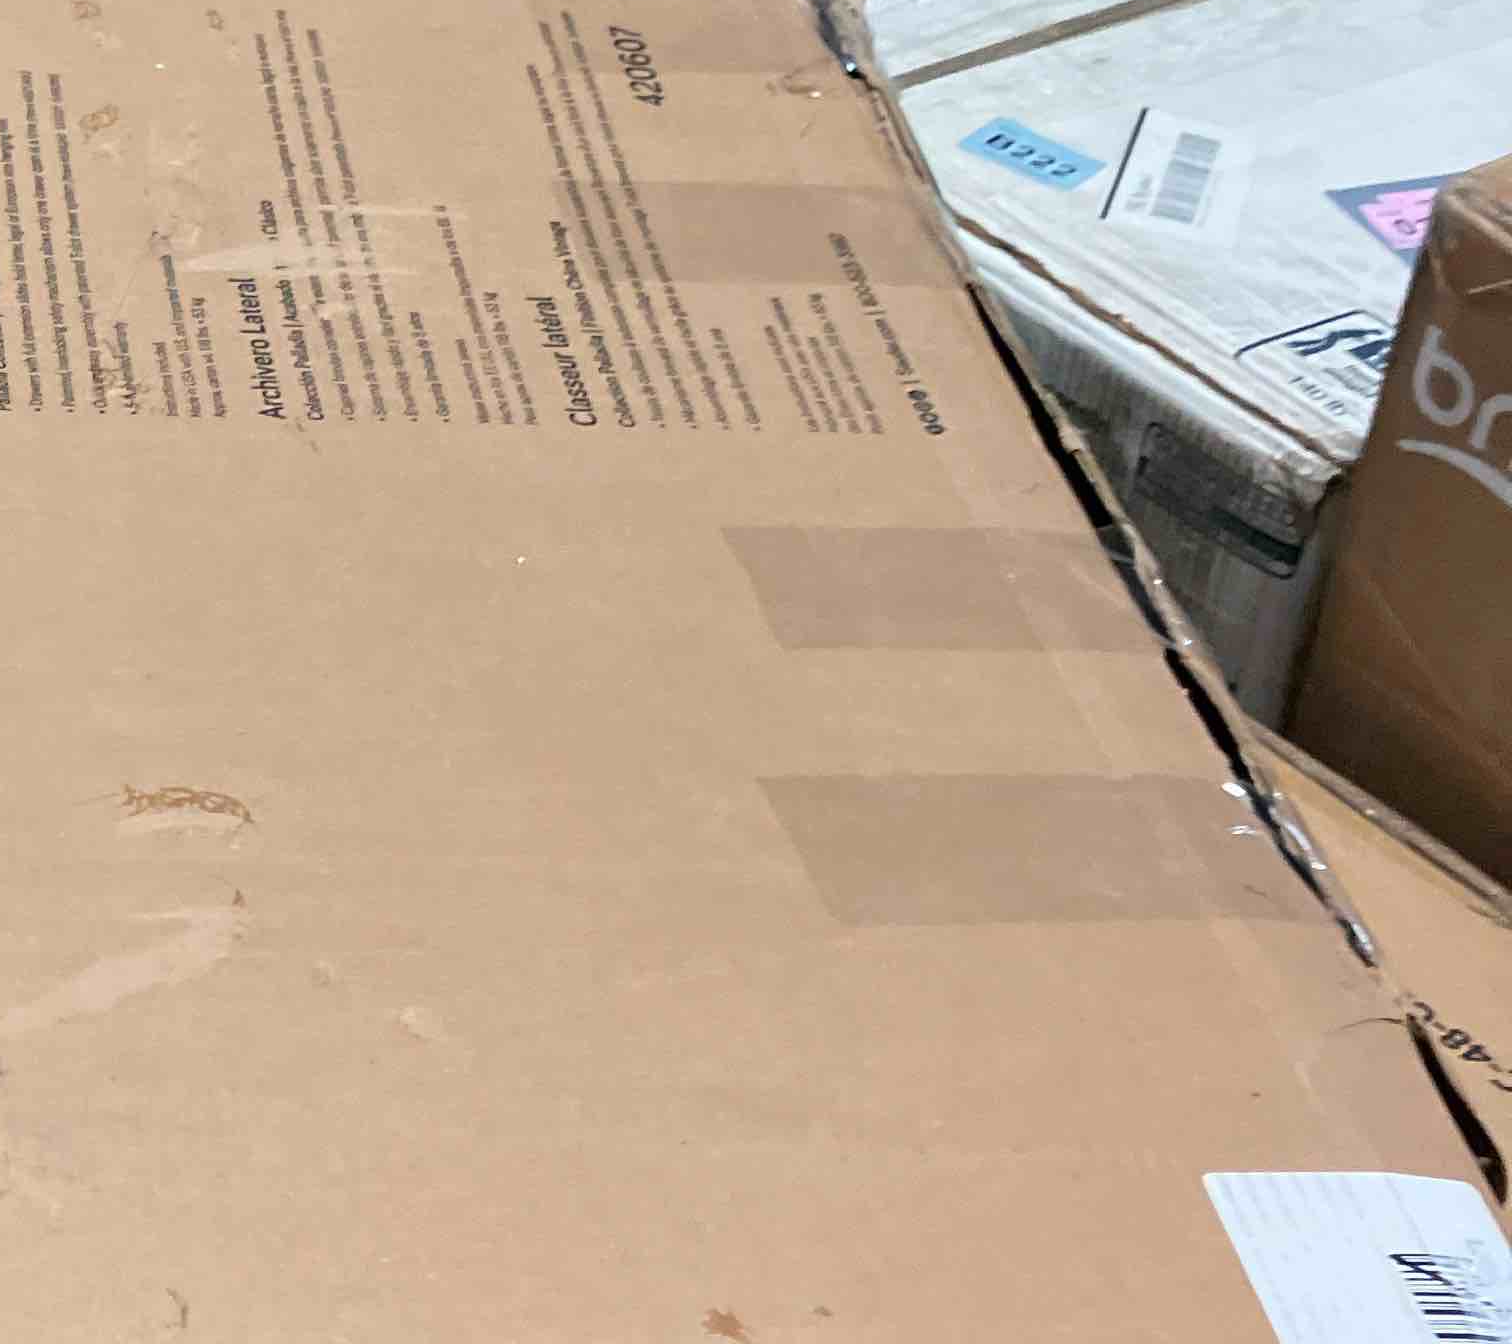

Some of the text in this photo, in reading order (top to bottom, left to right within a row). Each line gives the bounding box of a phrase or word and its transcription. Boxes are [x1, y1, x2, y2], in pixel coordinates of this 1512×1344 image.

[610, 27, 662, 105] 420607
[229, 278, 284, 418] Archivero Lateral
[288, 330, 309, 368] Palladia
[527, 297, 596, 425] Classeur latéral
[590, 335, 614, 373] Palladia
[607, 376, 635, 427] Collection
